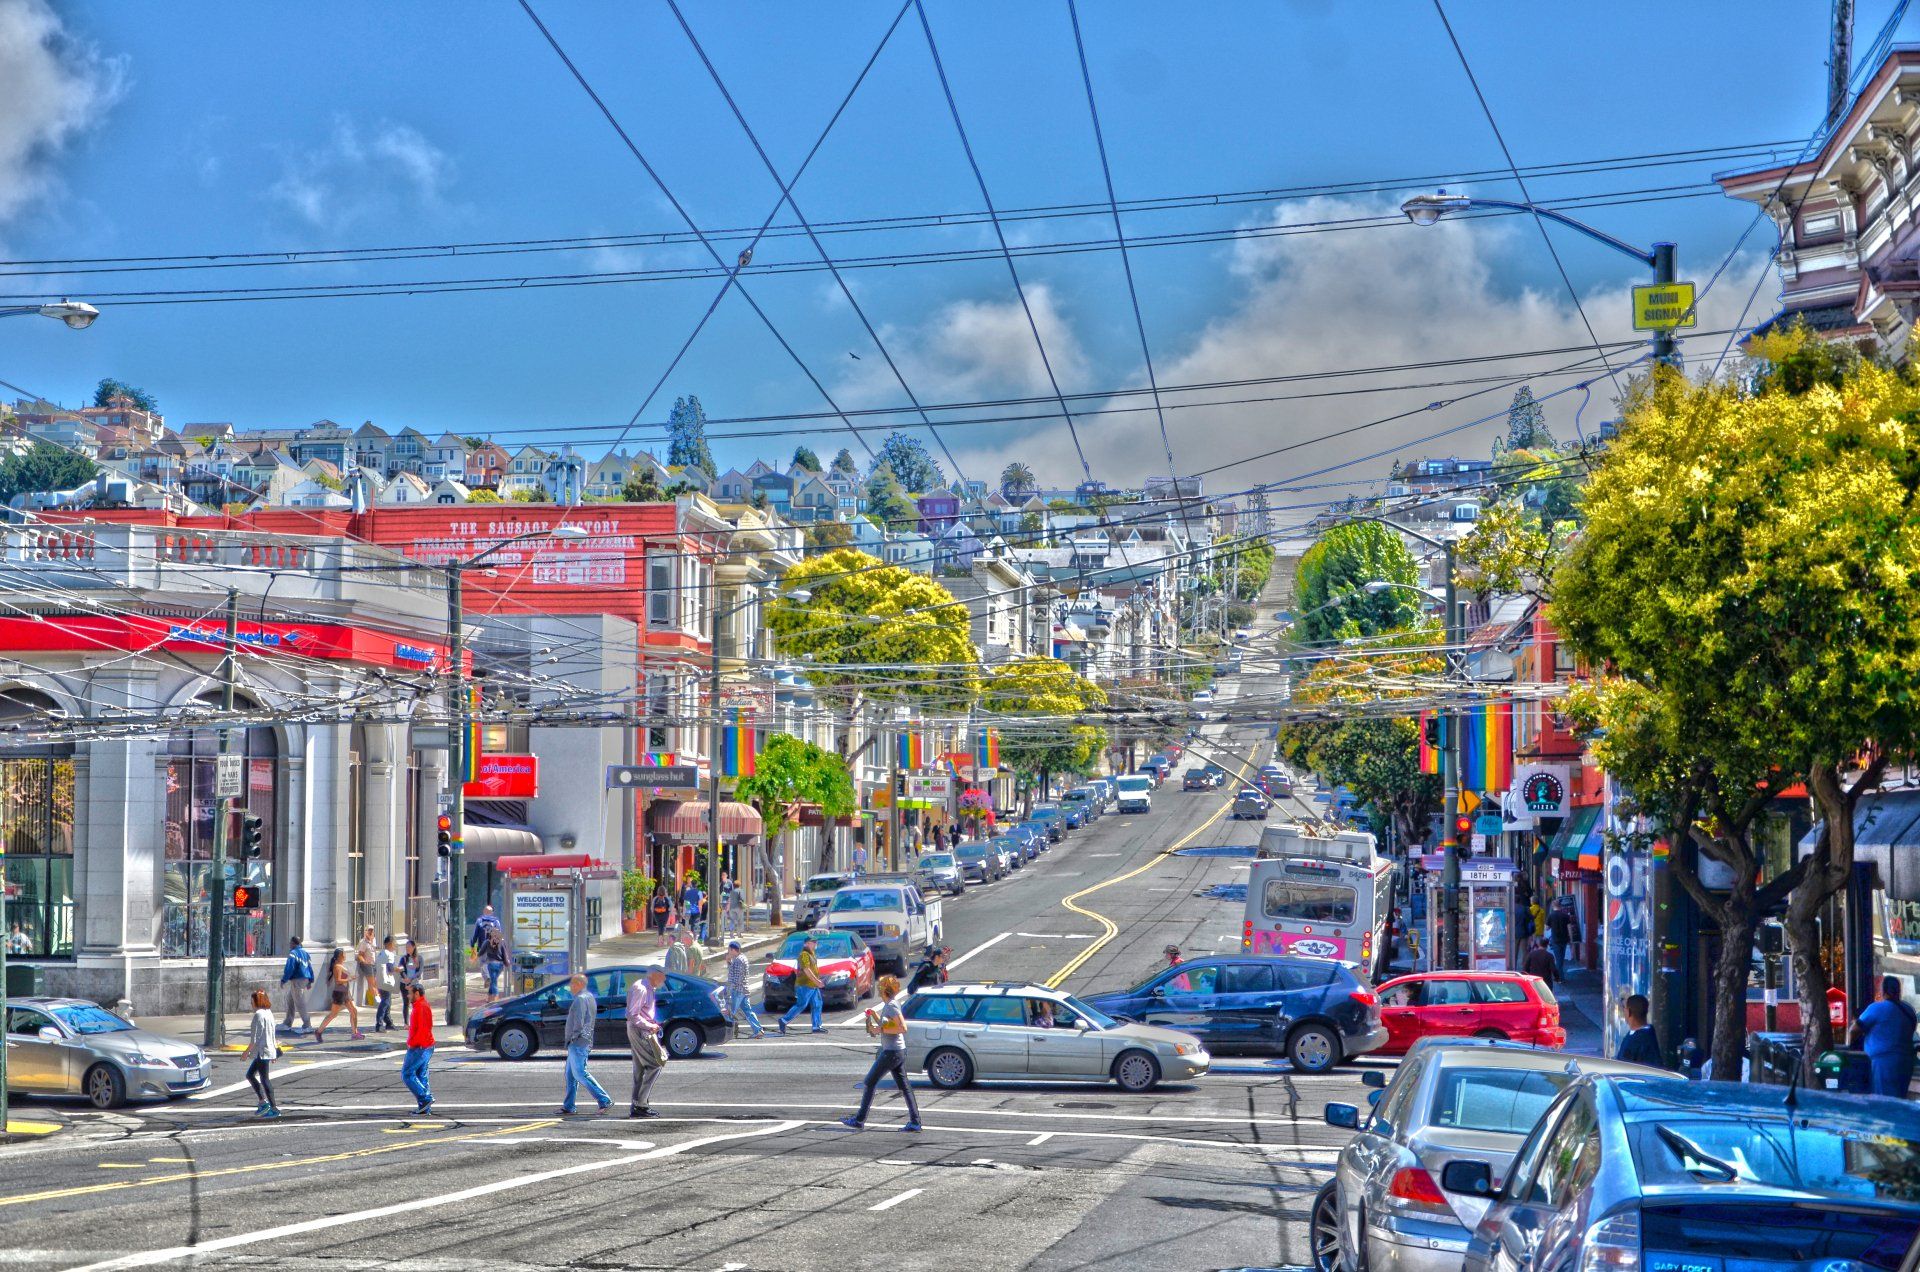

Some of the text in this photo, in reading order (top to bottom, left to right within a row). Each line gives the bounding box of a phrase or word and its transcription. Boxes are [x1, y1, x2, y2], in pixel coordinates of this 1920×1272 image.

[1648, 292, 1679, 305] MUNI
[1644, 308, 1682, 321] SIGNAL
[450, 522, 477, 535] THE
[488, 521, 549, 535] SAUSAGE
[492, 765, 530, 774] America
[633, 771, 684, 783] sunglass hut
[1547, 775, 1557, 783] NEW
[1654, 1262, 1679, 1270] GARY
